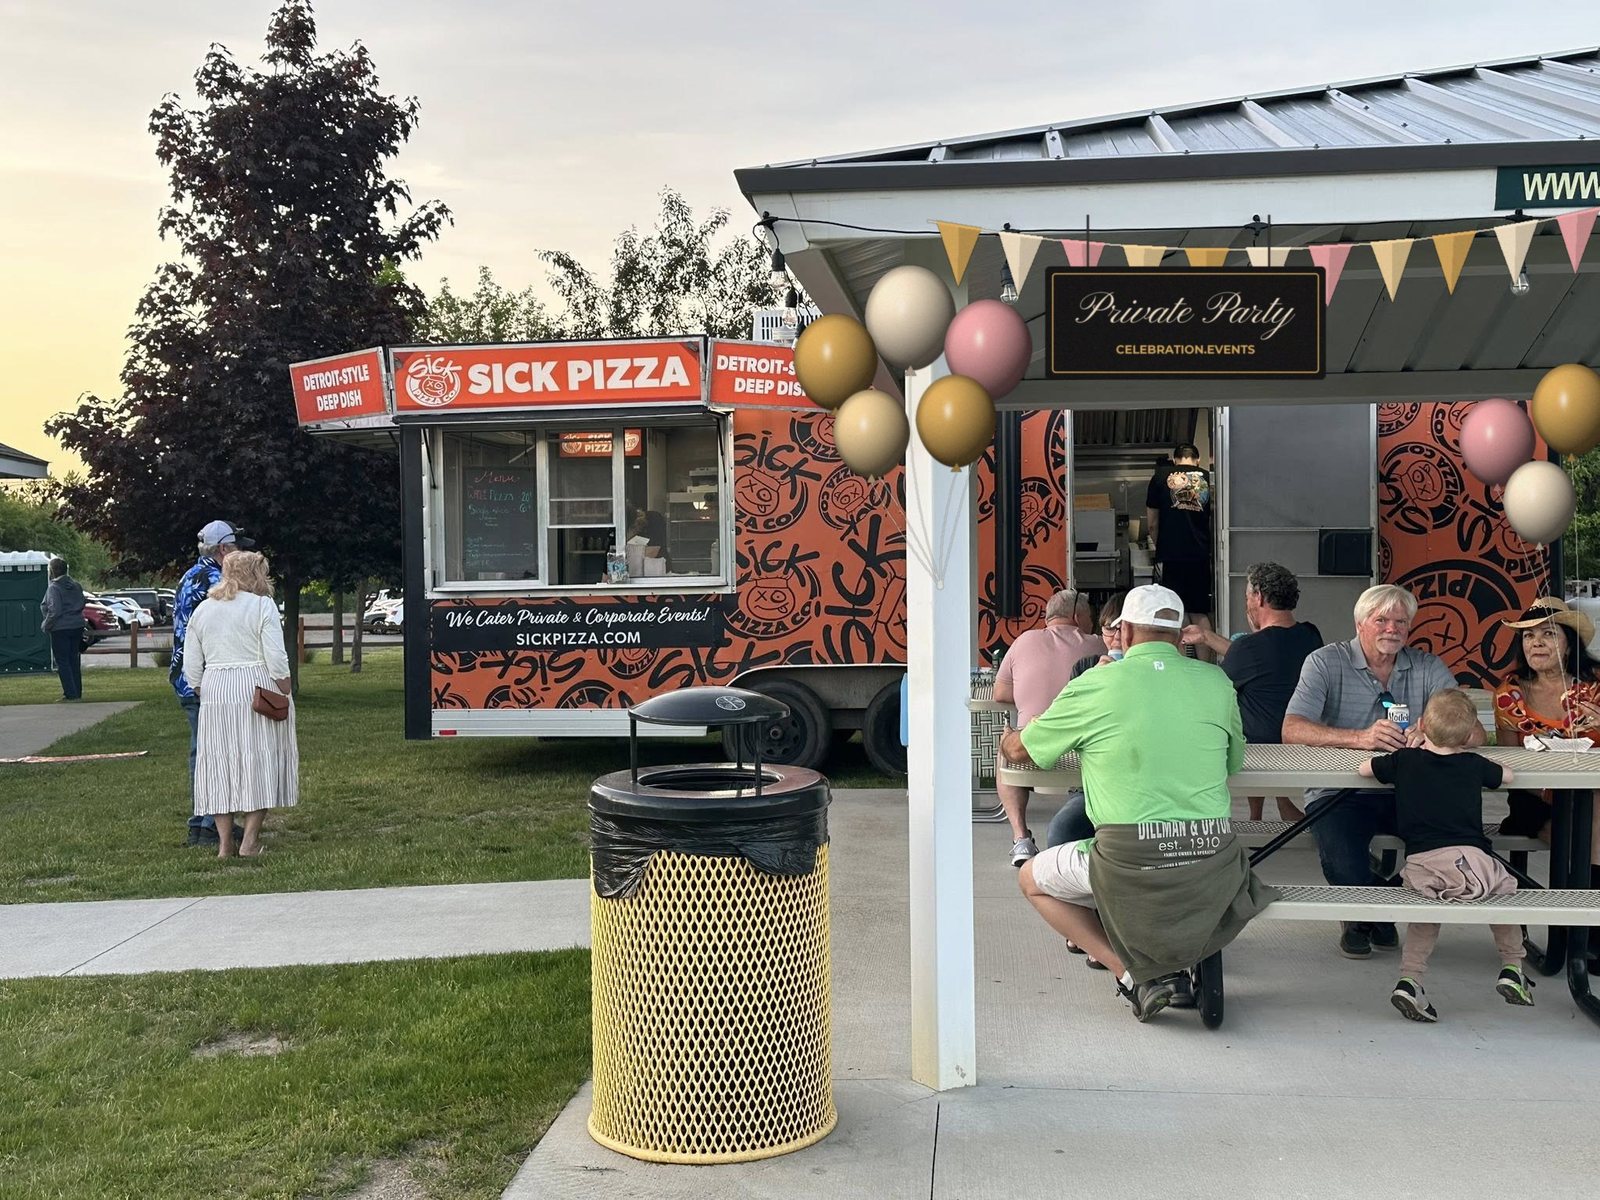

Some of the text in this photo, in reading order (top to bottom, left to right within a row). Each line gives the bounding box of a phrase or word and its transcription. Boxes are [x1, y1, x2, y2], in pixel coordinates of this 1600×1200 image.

[1075, 291, 1296, 341] Private Party
[1115, 344, 1256, 355] CELEBRATION.EVENTS
[408, 354, 463, 384] SICK
[467, 355, 690, 395] SICK PIZZA
[716, 354, 796, 375] DETROIT-S
[303, 364, 370, 392] DETROIT-STYLE
[734, 378, 775, 394] DEEP
[316, 389, 362, 412] DEEP DISH
[446, 606, 710, 628] We Cater Private & Corporate Events!
[728, 609, 790, 635] PIZZA
[516, 632, 641, 646] SICKPIZZA.COM
[1190, 821, 1198, 836] &
[1159, 836, 1220, 851] est. 1910
